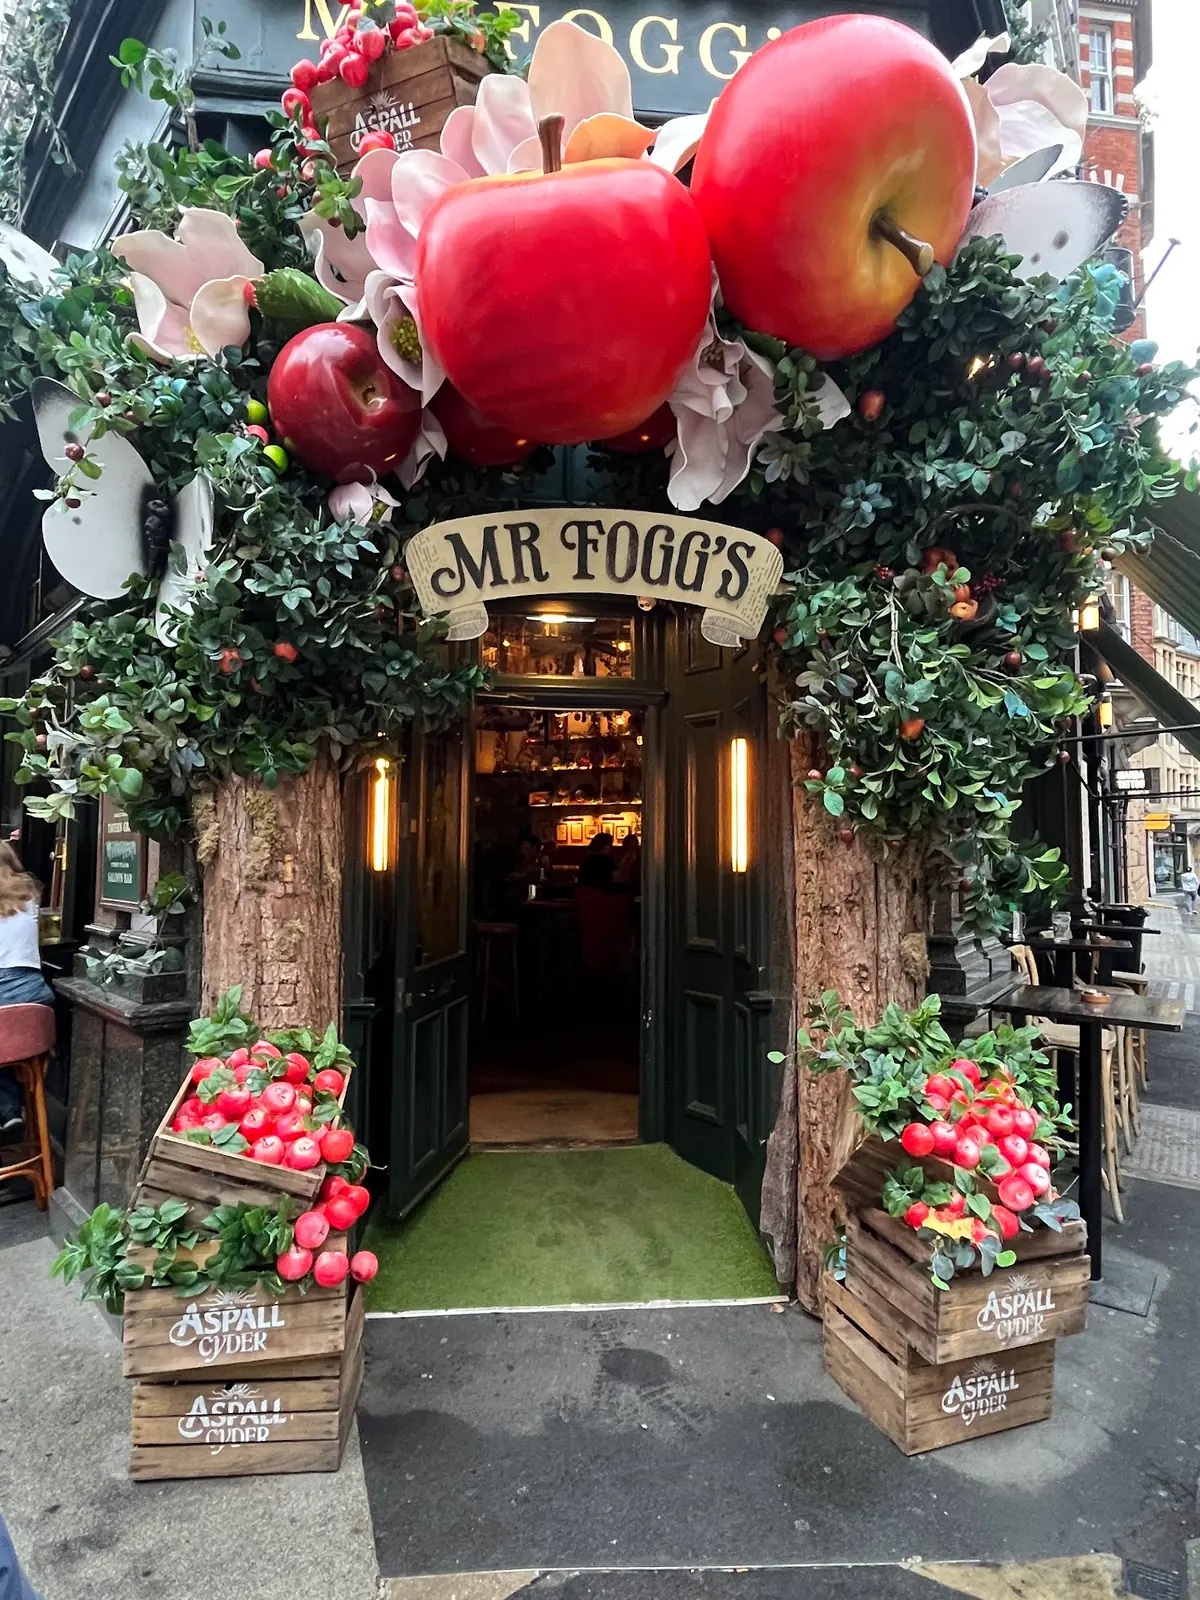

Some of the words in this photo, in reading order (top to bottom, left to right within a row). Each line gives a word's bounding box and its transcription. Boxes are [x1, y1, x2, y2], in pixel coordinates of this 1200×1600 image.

[350, 102, 421, 152] ASPALL
[430, 521, 549, 598] MR
[560, 519, 756, 600] FOGG'S
[169, 1301, 285, 1347] ASPALL
[976, 1288, 1055, 1331] ASPALL
[997, 1314, 1047, 1346] CYDER
[199, 1330, 268, 1363] CYDER
[942, 1368, 1019, 1414] ASPALL
[961, 1393, 1008, 1426] CYDER
[178, 1395, 286, 1438] ASPALL
[205, 1427, 270, 1456] CYDER
